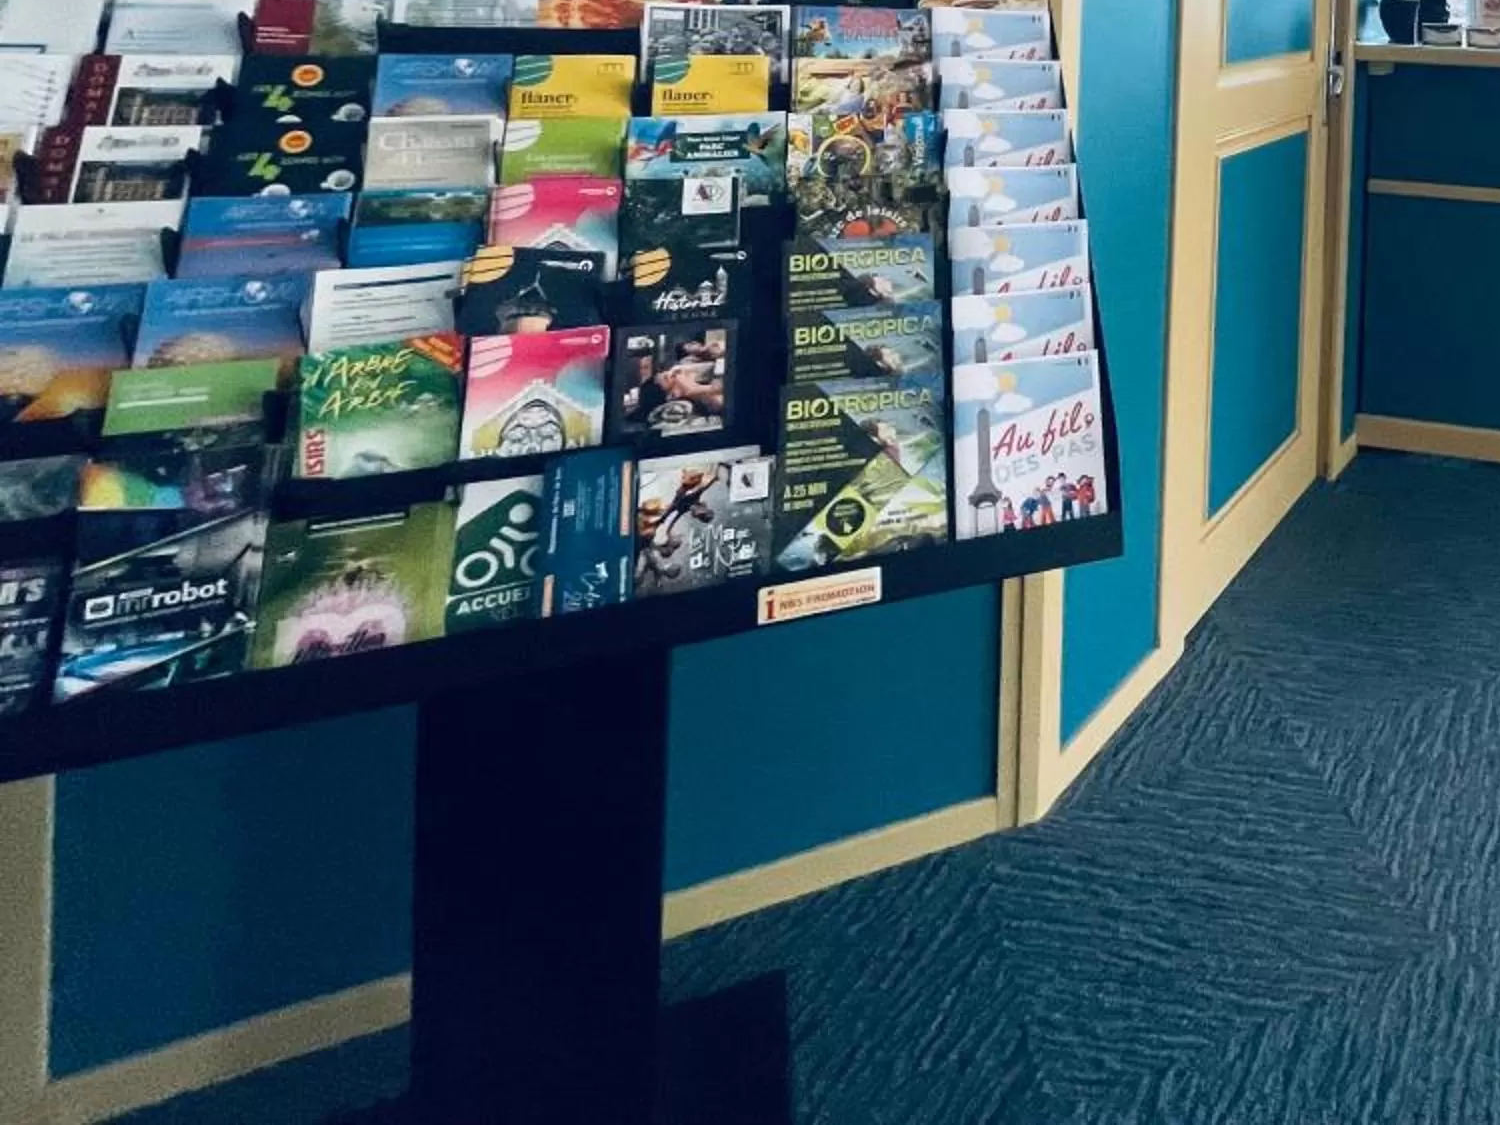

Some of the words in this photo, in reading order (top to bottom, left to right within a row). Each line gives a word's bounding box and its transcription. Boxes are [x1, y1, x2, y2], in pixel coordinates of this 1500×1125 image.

[788, 246, 927, 273] BIOTROPICA
[793, 315, 935, 346] BIOTROPICA
[786, 388, 934, 421] BIOTROPICA
[991, 423, 1035, 460] Au
[1040, 400, 1085, 456] fil
[994, 454, 1041, 484] DES
[1051, 433, 1096, 463] PAS
